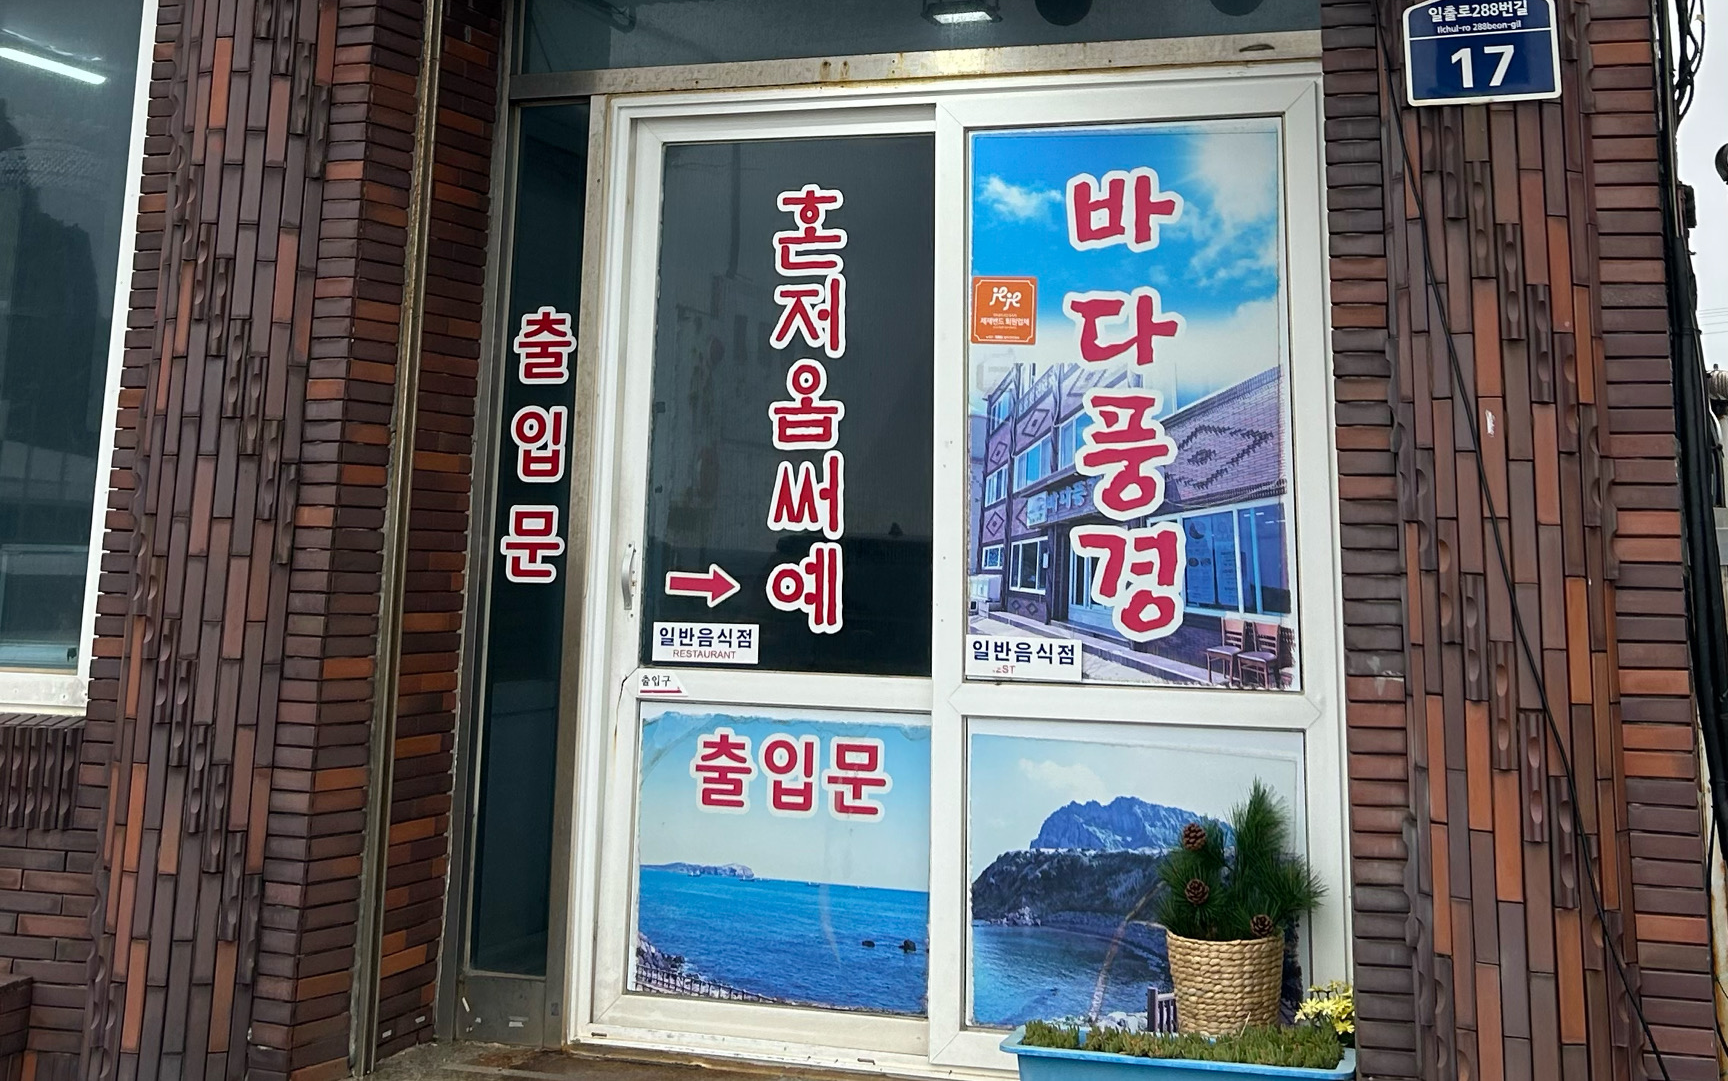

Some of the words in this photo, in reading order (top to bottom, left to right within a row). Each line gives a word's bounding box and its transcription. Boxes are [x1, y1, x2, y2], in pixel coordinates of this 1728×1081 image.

[1428, 0, 1528, 23] 일출로288번길
[1436, 25, 1471, 34] Ilchul-ro
[1472, 19, 1522, 32] 288beon-gil
[1451, 44, 1515, 89] 17
[769, 187, 844, 629] 혼저옵써예
[1067, 170, 1182, 637] 바다풍경
[659, 626, 753, 649] 일반음식점
[672, 649, 737, 659] RESTAURANT
[972, 640, 1076, 666] 일반음식점
[641, 675, 671, 687] 출입구
[693, 731, 889, 818] 출입문
